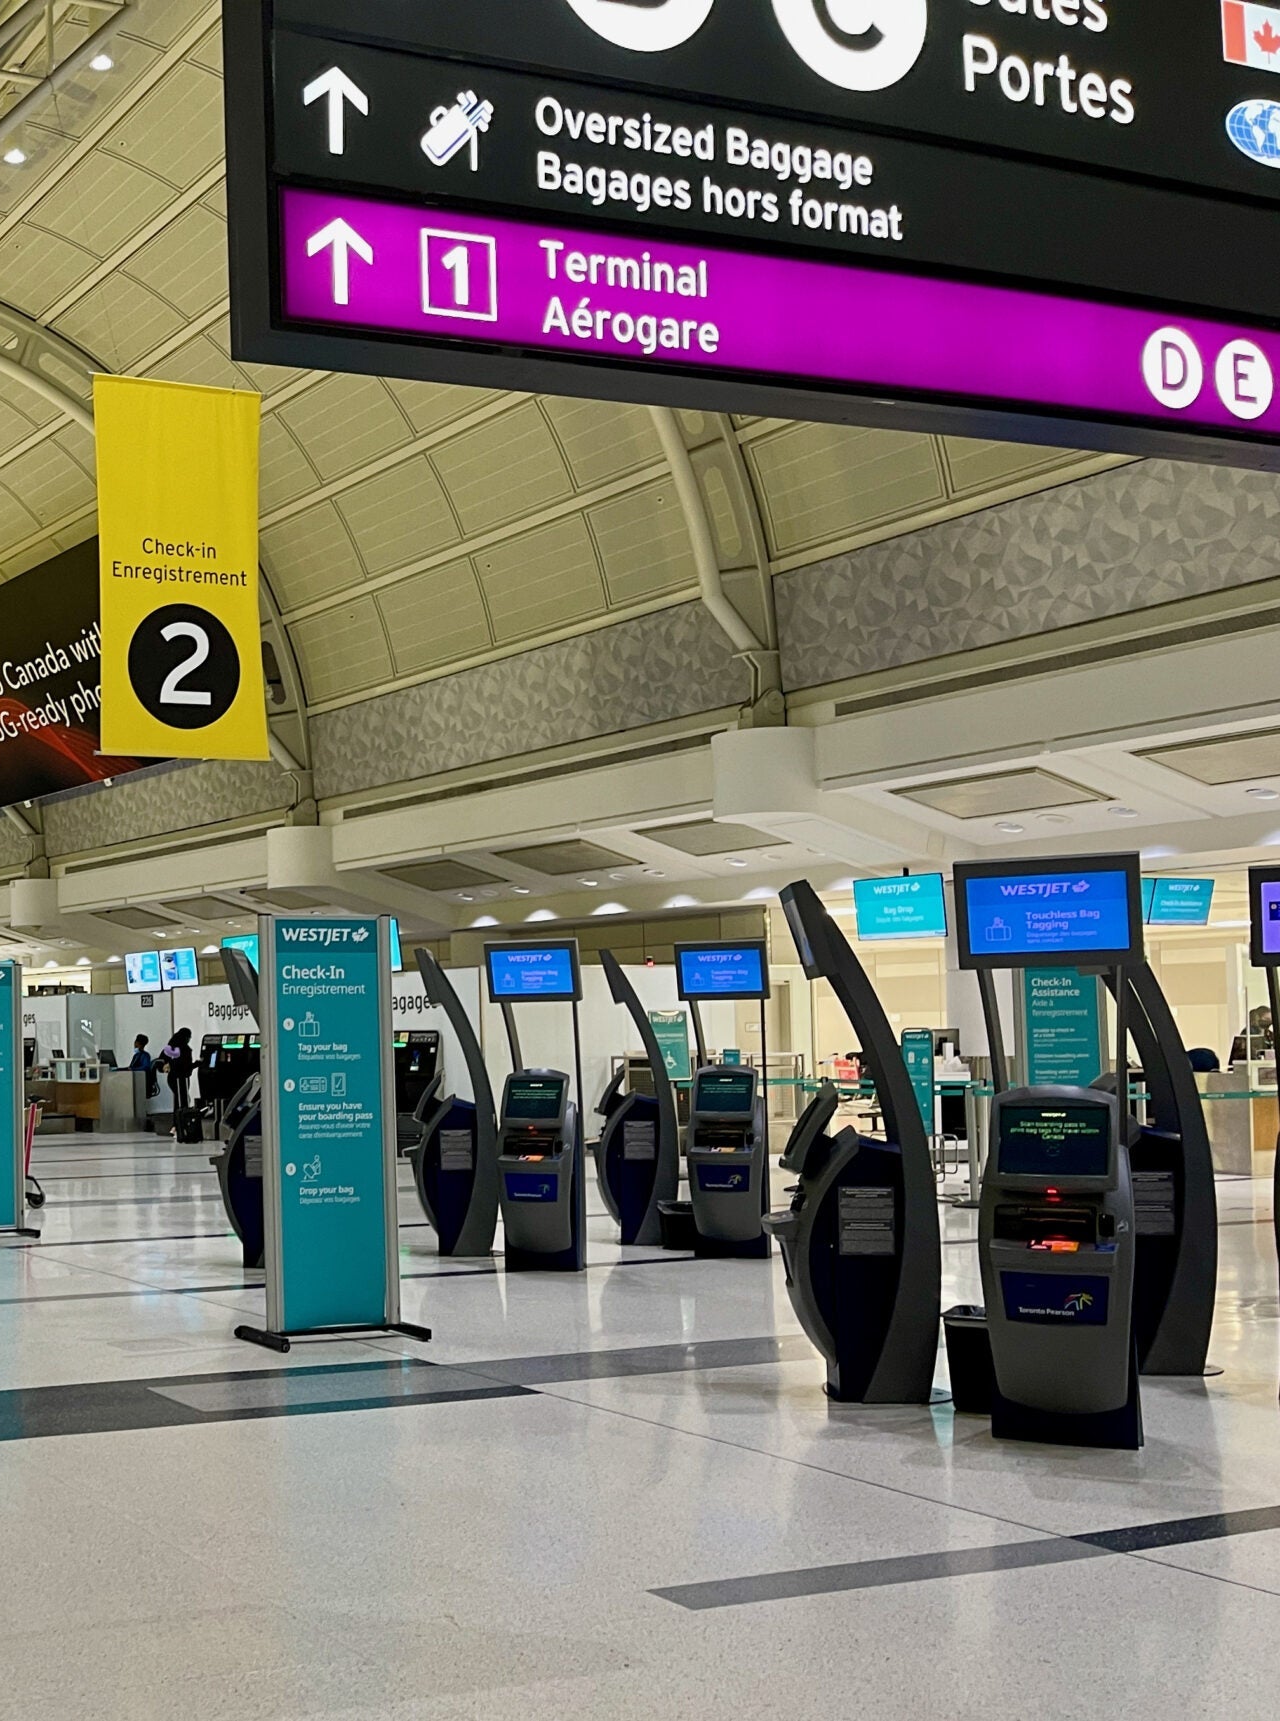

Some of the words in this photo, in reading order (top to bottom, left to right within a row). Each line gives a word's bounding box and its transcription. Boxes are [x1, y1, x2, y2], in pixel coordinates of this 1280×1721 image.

[962, 33, 1136, 125] Portes
[535, 96, 716, 161] Oversized
[725, 127, 874, 187] Baggage
[537, 150, 693, 213] Bagages
[703, 176, 780, 224] hors
[788, 188, 904, 242] format
[443, 246, 471, 306] 1
[539, 239, 708, 299] Terminal
[542, 296, 721, 355] Aérogare
[1160, 341, 1189, 393] D
[1232, 353, 1257, 403] E
[142, 537, 217, 560] Check-in
[112, 561, 248, 587] Enregistrement
[2, 641, 71, 690] Canada
[160, 621, 212, 706] 2
[70, 680, 101, 723] pho
[873, 883, 911, 896] WESTJET
[1000, 882, 1071, 898] WESTJET
[1025, 911, 1077, 920] Touchless
[1079, 909, 1101, 919] Bag
[1026, 921, 1069, 931] Tagging
[281, 927, 352, 947] WESTJET
[507, 954, 543, 964] WESTJET
[697, 954, 733, 964] WESTJET
[282, 965, 346, 980] Check-In
[1031, 977, 1072, 987] Check-In
[282, 983, 366, 999] Enregistrement
[1032, 988, 1080, 997] Assistance
[1032, 999, 1048, 1007] Aide
[297, 1043, 312, 1054] Tag
[313, 1043, 331, 1054] your
[332, 1042, 348, 1053] bag
[298, 1103, 325, 1111] Ensure
[326, 1103, 342, 1113] you
[342, 1102, 363, 1110] have
[298, 1114, 317, 1123] your
[317, 1112, 355, 1122] boarding
[355, 1112, 374, 1121] pass
[299, 1187, 318, 1197] Drop
[318, 1186, 338, 1197] your
[338, 1185, 354, 1195] bag
[1019, 1306, 1046, 1314] Toronto
[1046, 1308, 1075, 1316] Pearson
